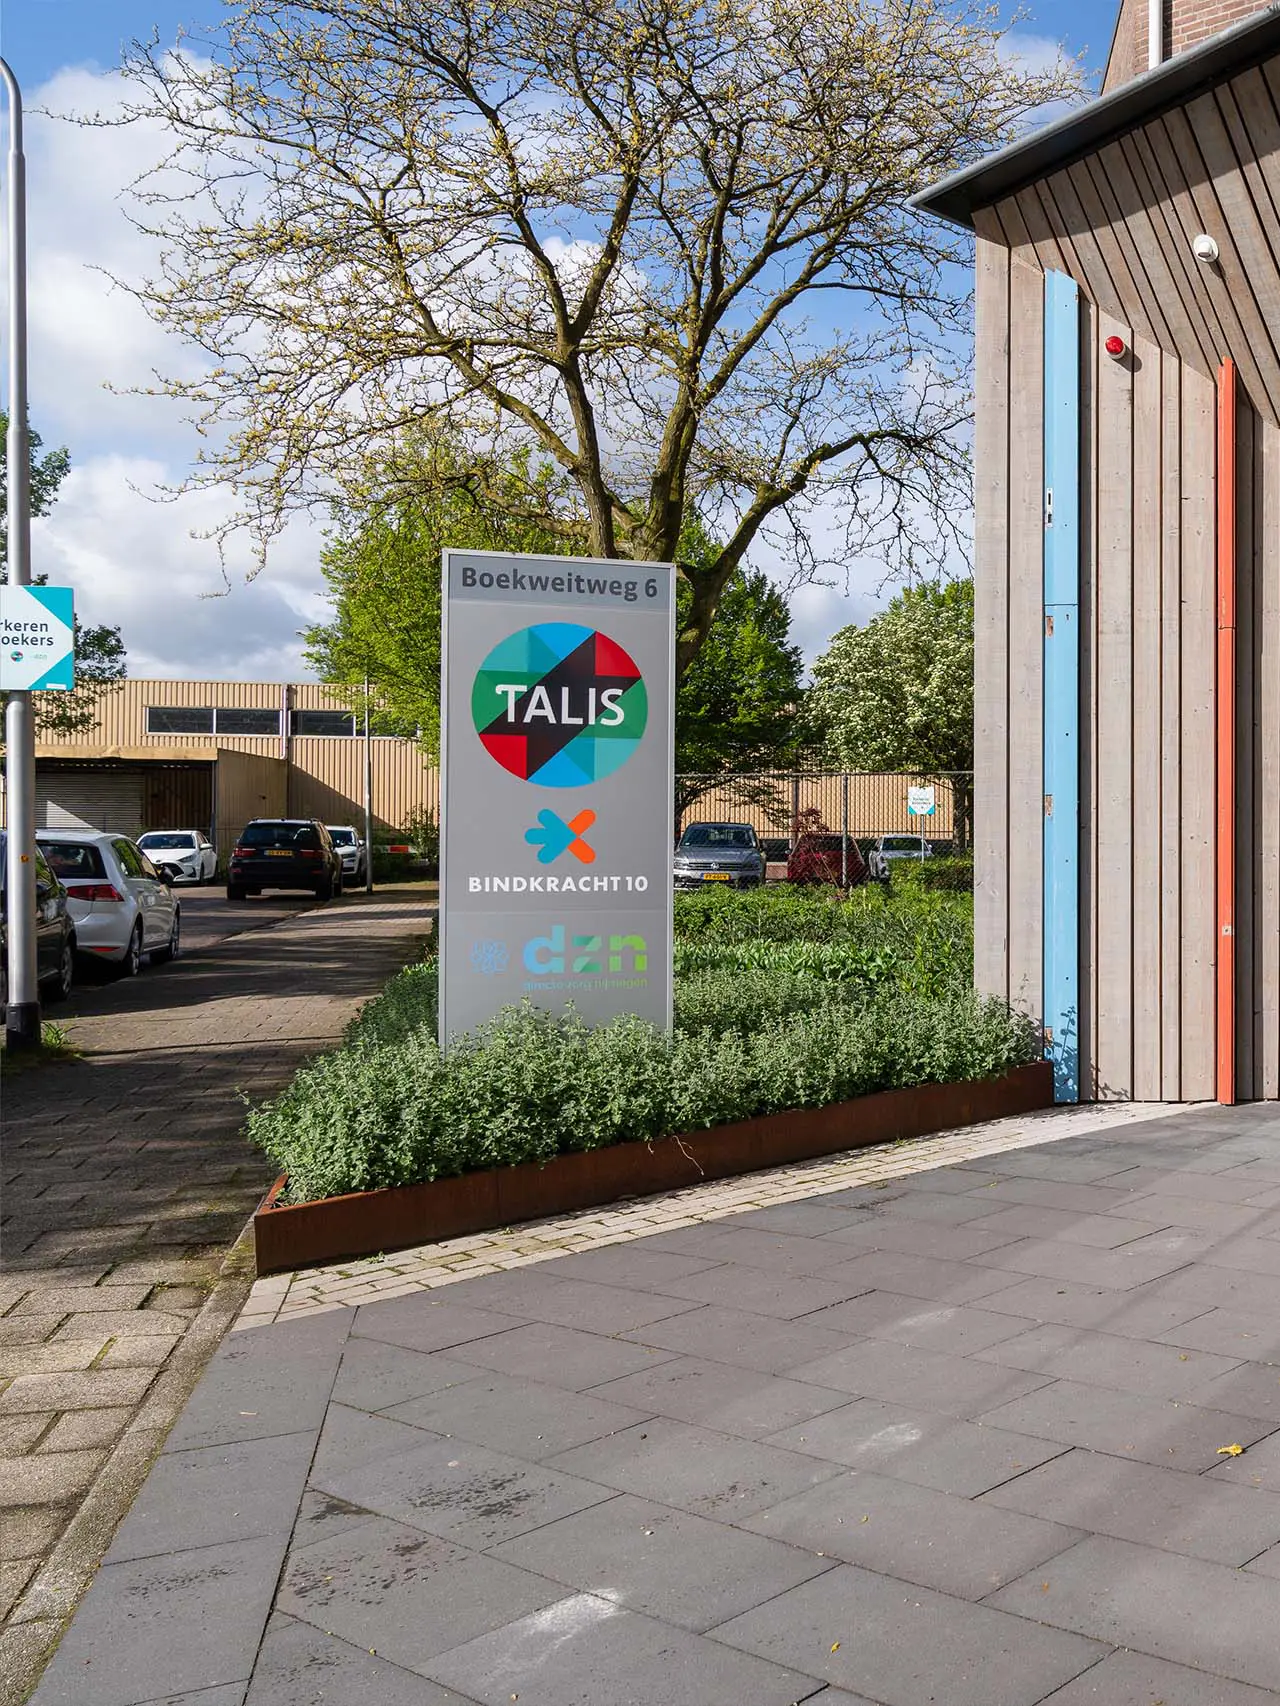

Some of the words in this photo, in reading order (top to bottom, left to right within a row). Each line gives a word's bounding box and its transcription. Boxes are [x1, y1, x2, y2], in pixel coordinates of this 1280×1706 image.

[461, 567, 638, 602] Boekweitweg
[645, 578, 658, 598] 6
[495, 684, 625, 726] TALIS
[522, 924, 648, 974] dzn
